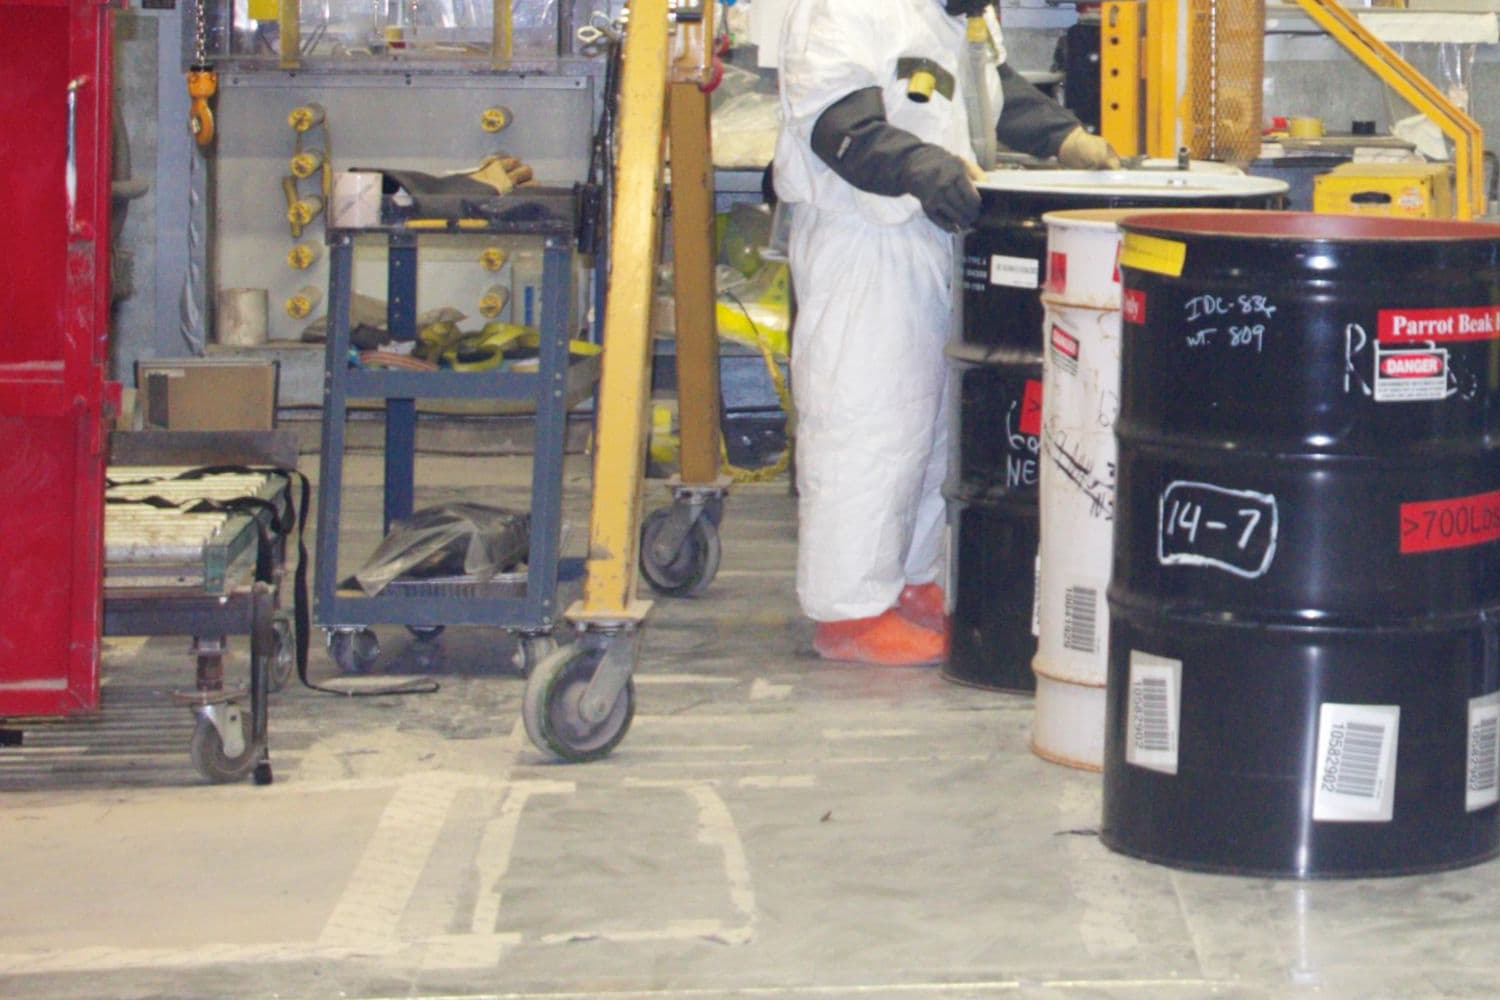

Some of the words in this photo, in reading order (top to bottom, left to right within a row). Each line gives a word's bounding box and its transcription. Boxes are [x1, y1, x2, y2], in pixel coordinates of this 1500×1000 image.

[1392, 315, 1454, 336] Parrot
[1458, 313, 1493, 333] Beak
[1229, 324, 1266, 352] 809
[1386, 359, 1438, 374] DANGER
[1321, 722, 1345, 793] 10582902
